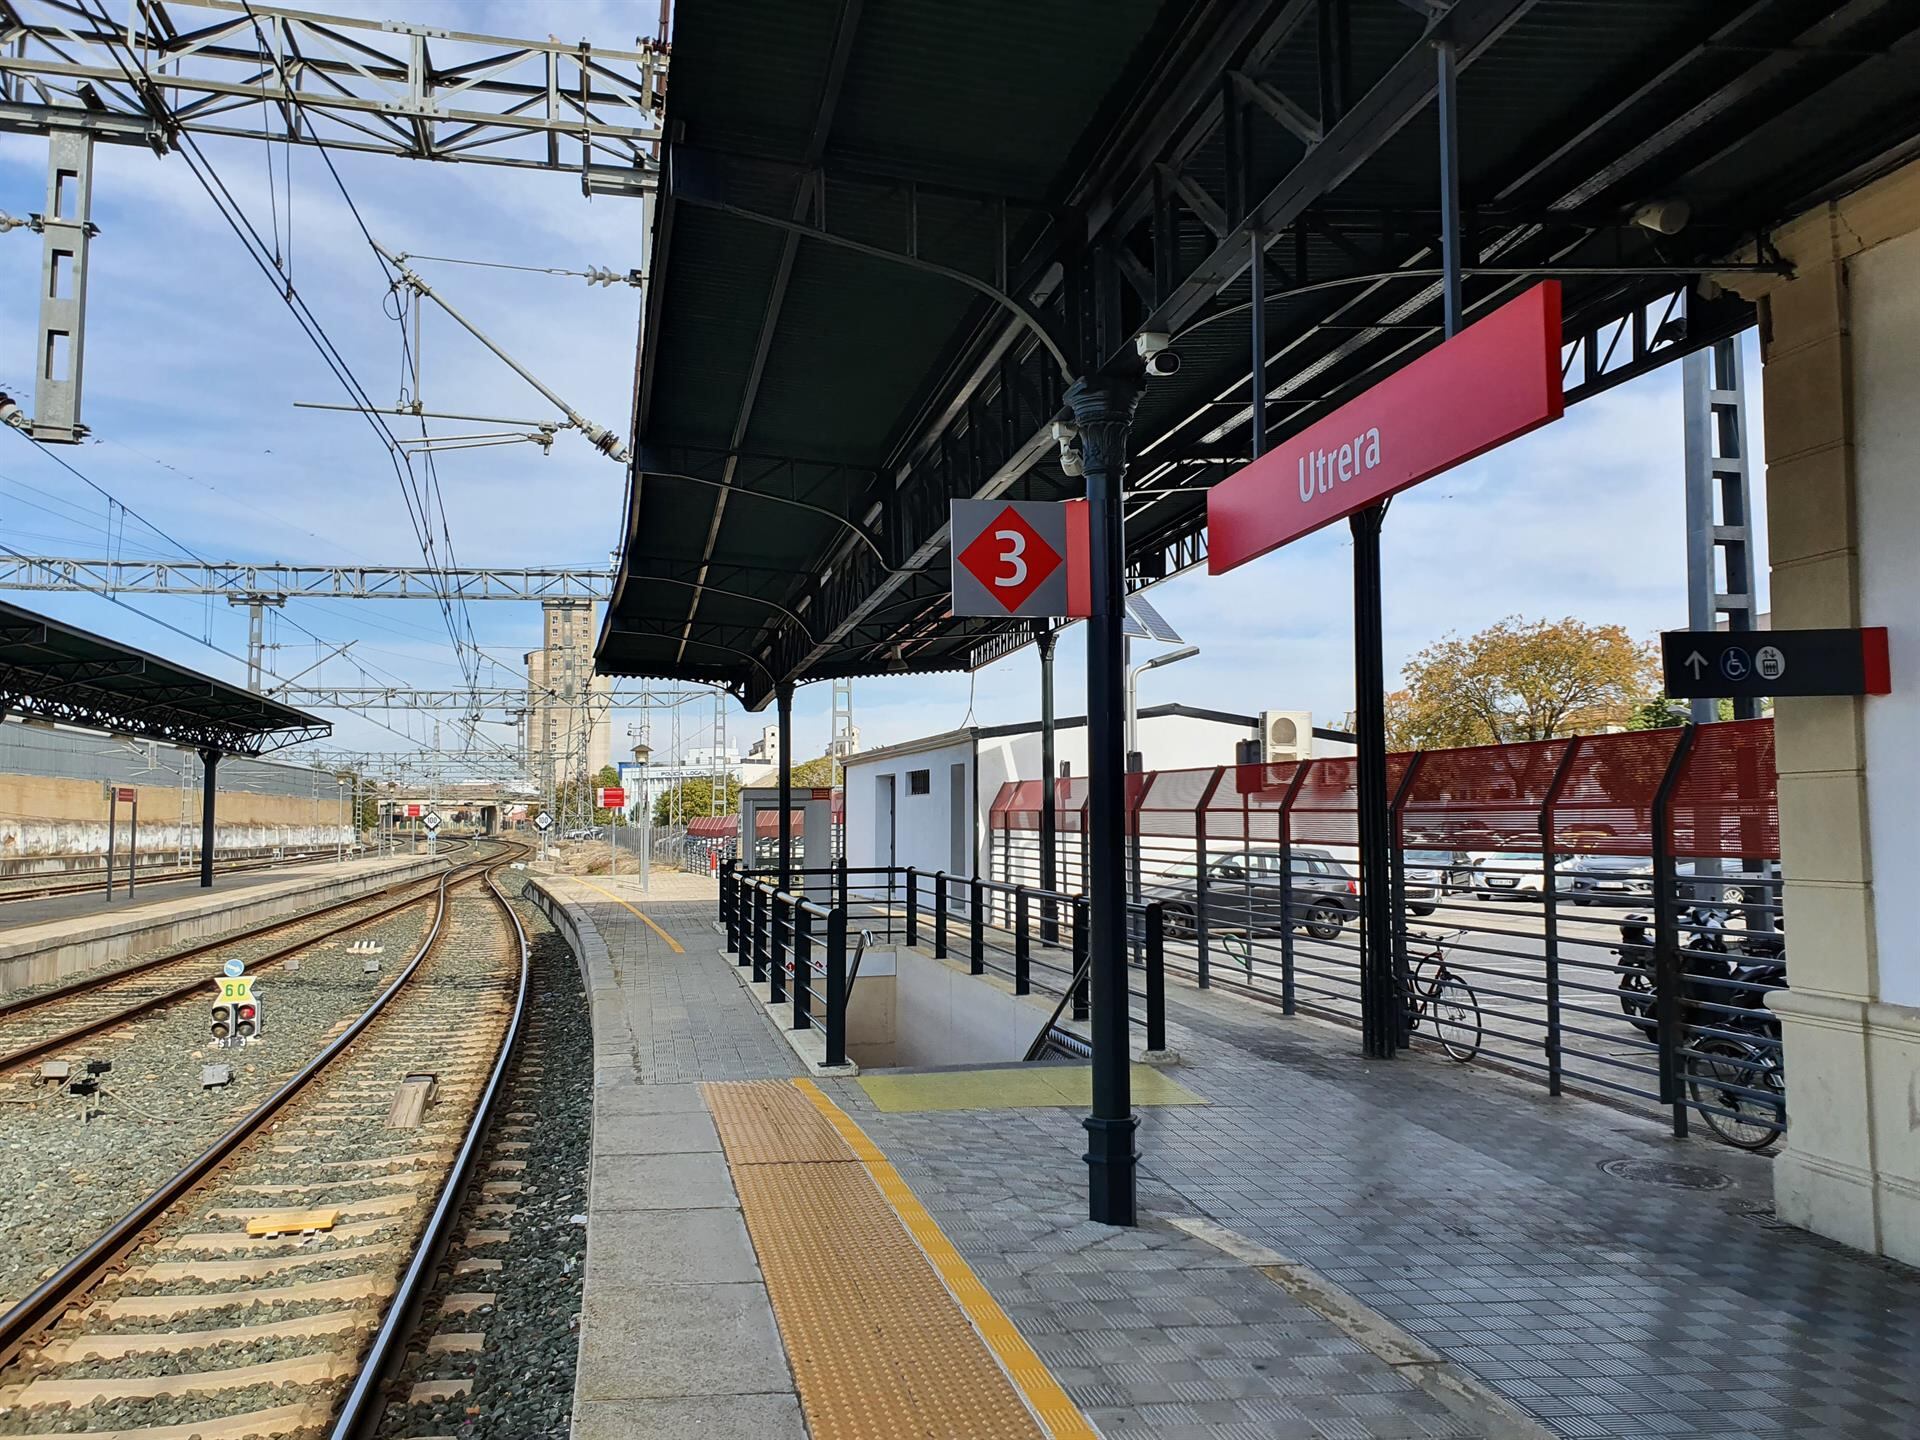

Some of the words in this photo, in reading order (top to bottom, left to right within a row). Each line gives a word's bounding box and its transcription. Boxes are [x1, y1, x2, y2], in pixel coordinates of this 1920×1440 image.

[1298, 427, 1381, 503] Utrera
[994, 529, 1028, 588] 3
[427, 816, 437, 824] 100
[538, 816, 549, 824] 100
[225, 983, 246, 997] 60
